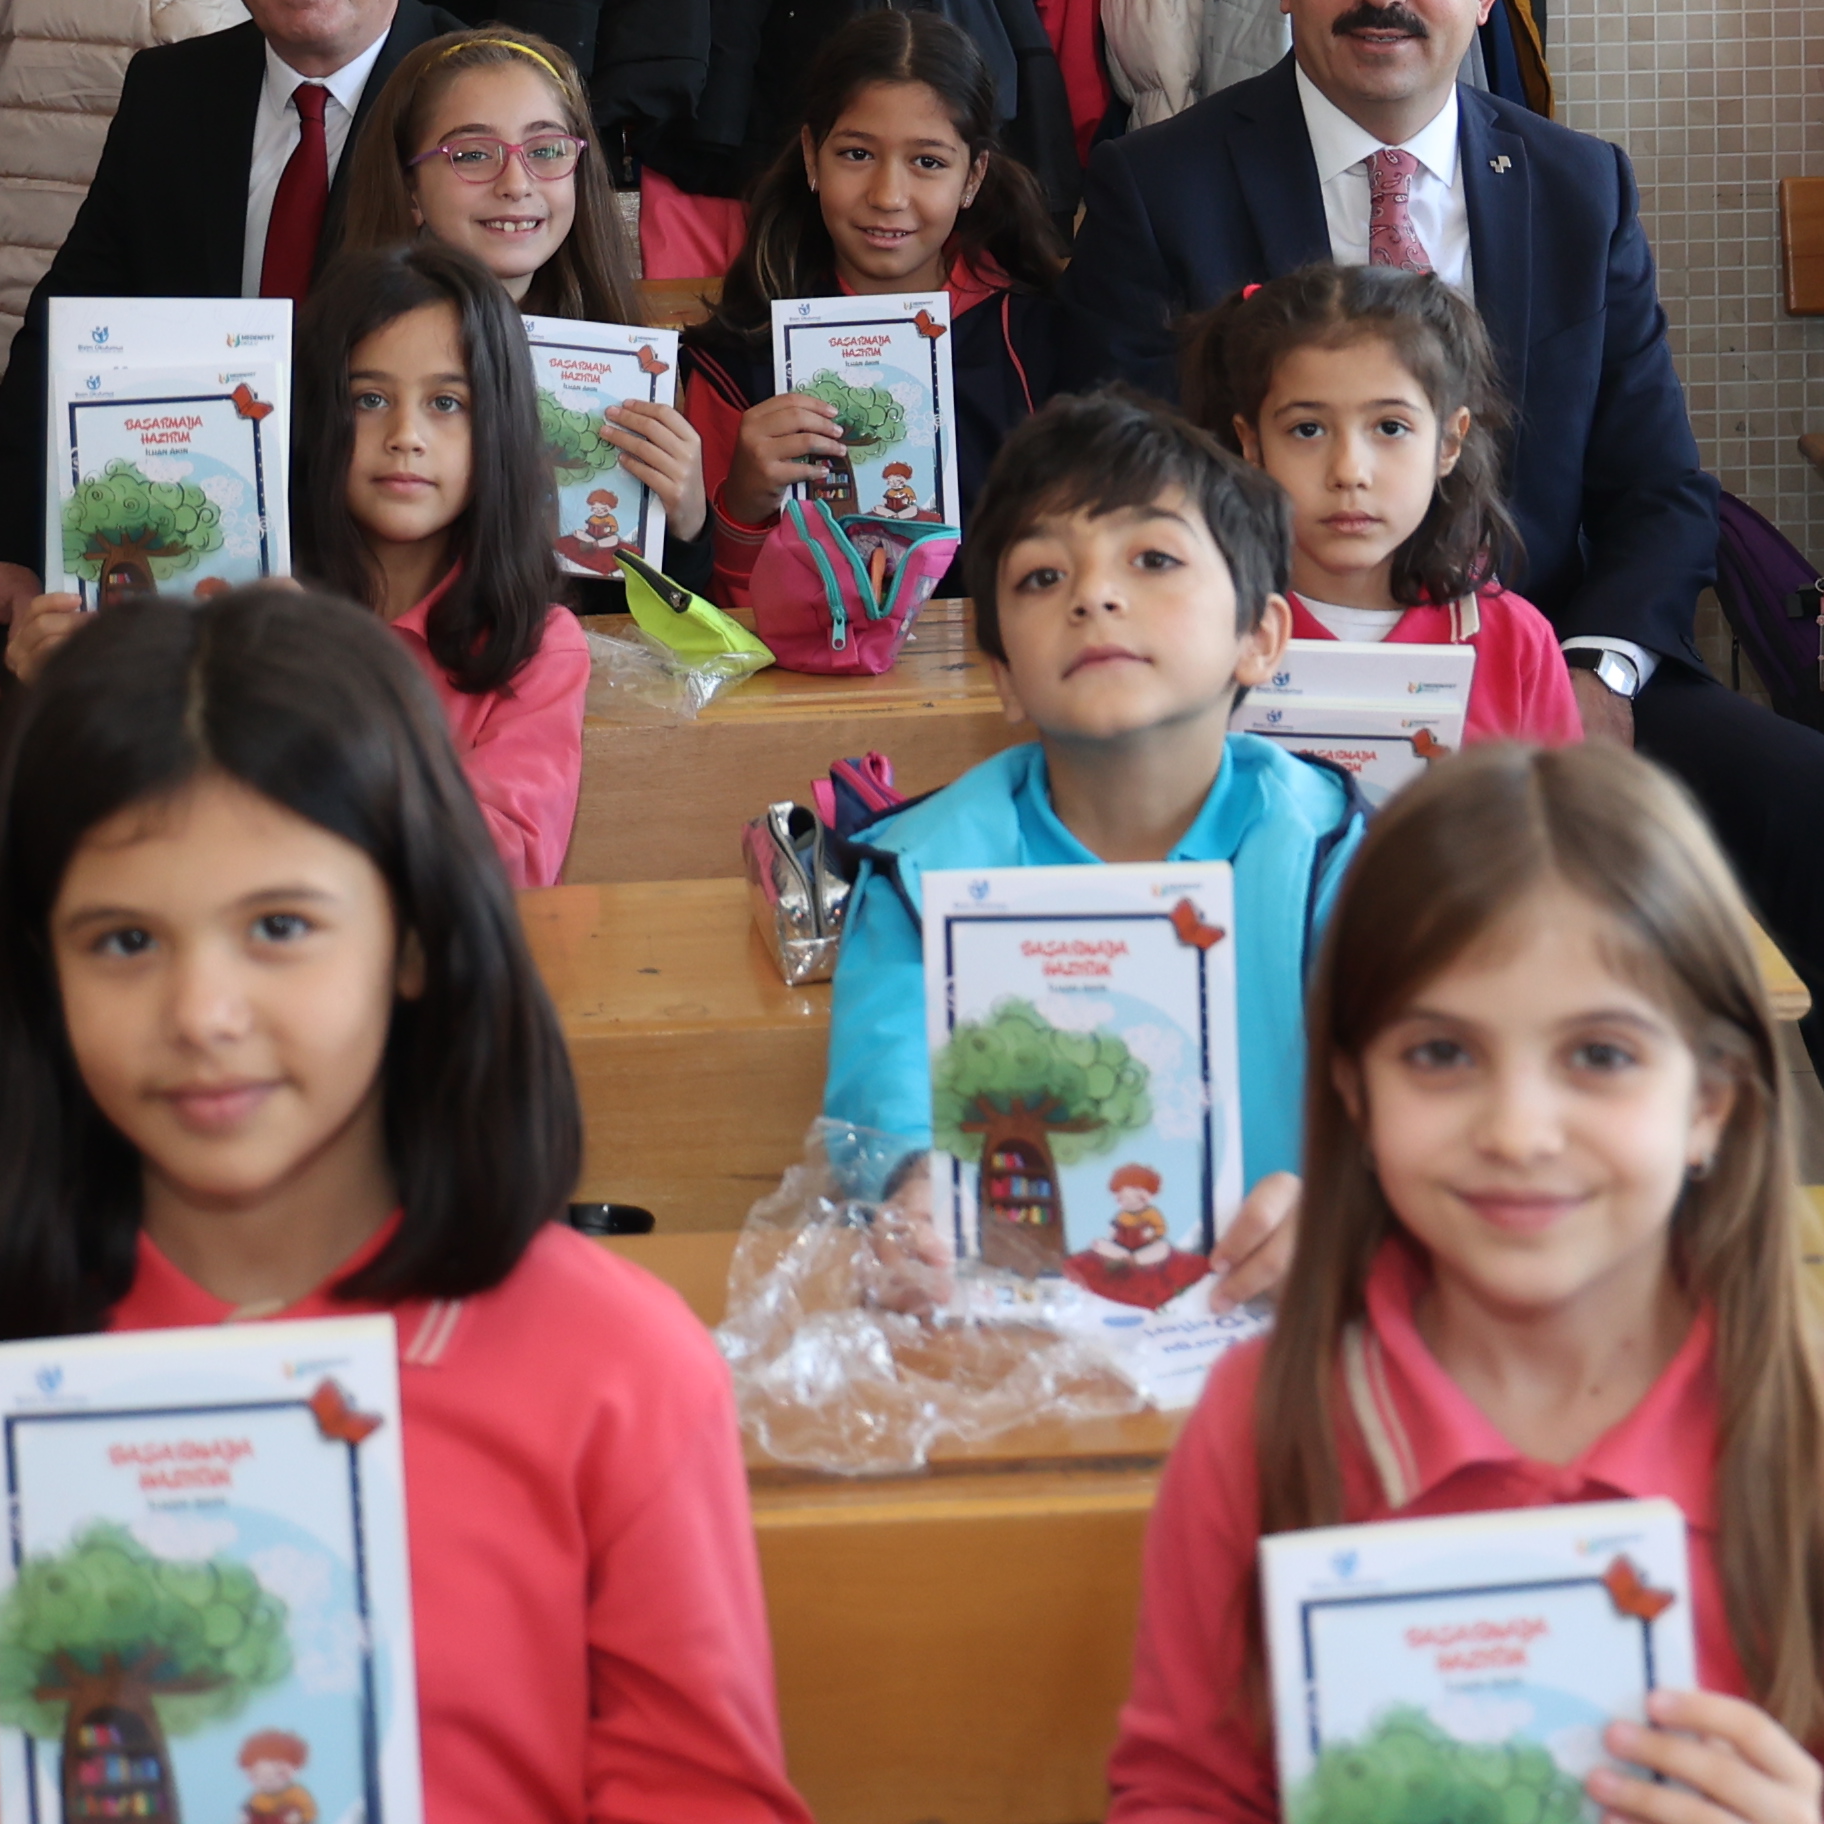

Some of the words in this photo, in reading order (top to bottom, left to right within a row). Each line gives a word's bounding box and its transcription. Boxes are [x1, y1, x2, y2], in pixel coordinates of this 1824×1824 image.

[842, 348, 882, 358] HAZIRIM
[561, 371, 601, 384] HAZIRIM
[124, 415, 203, 433] BAŞARMAYA
[140, 432, 191, 446] HAZIRIM
